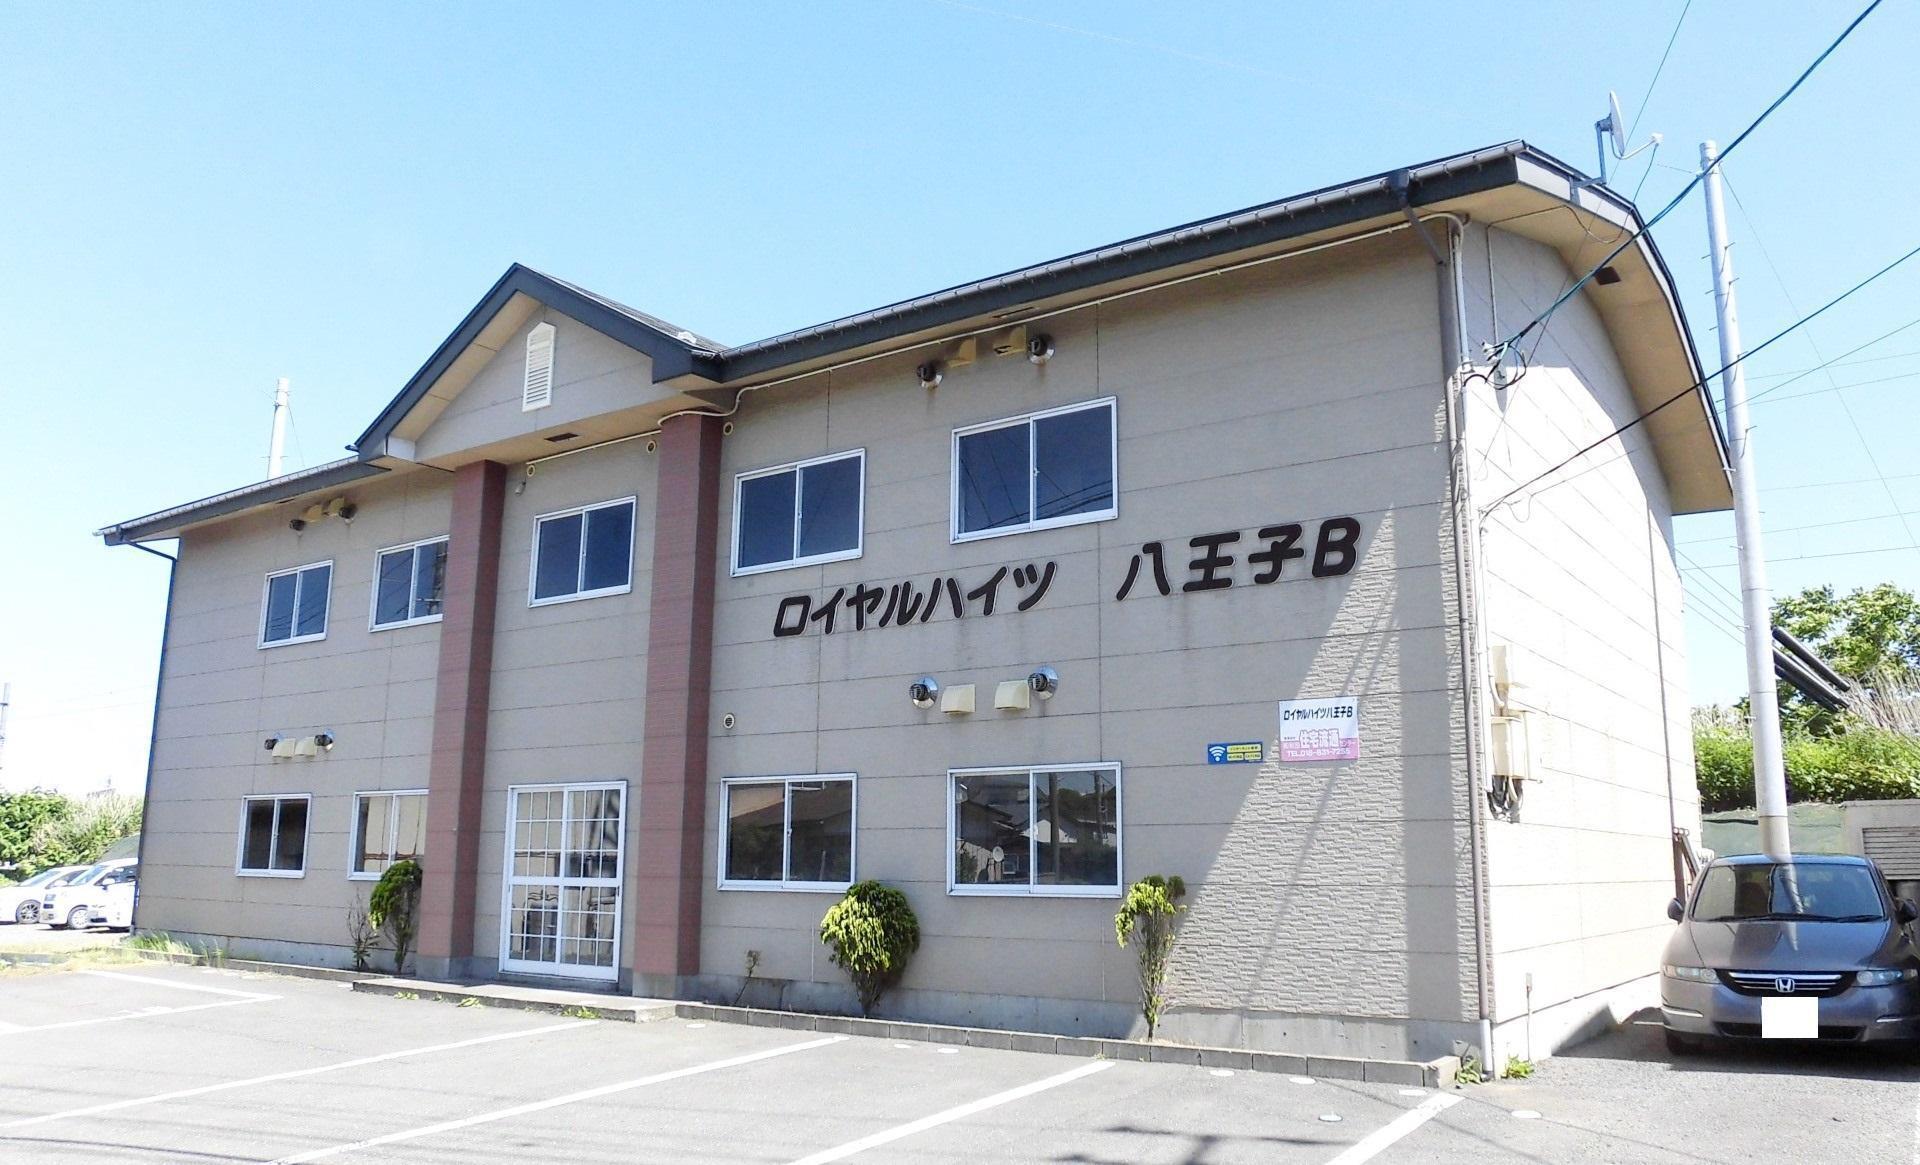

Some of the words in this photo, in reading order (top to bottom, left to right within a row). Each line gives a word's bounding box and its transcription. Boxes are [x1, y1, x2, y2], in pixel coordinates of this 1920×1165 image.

[773, 561, 1057, 638] ロイヤルハイツ
[1116, 516, 1361, 601] 八王子B
[1283, 705, 1353, 720] ロイヤルハイツ八王子B
